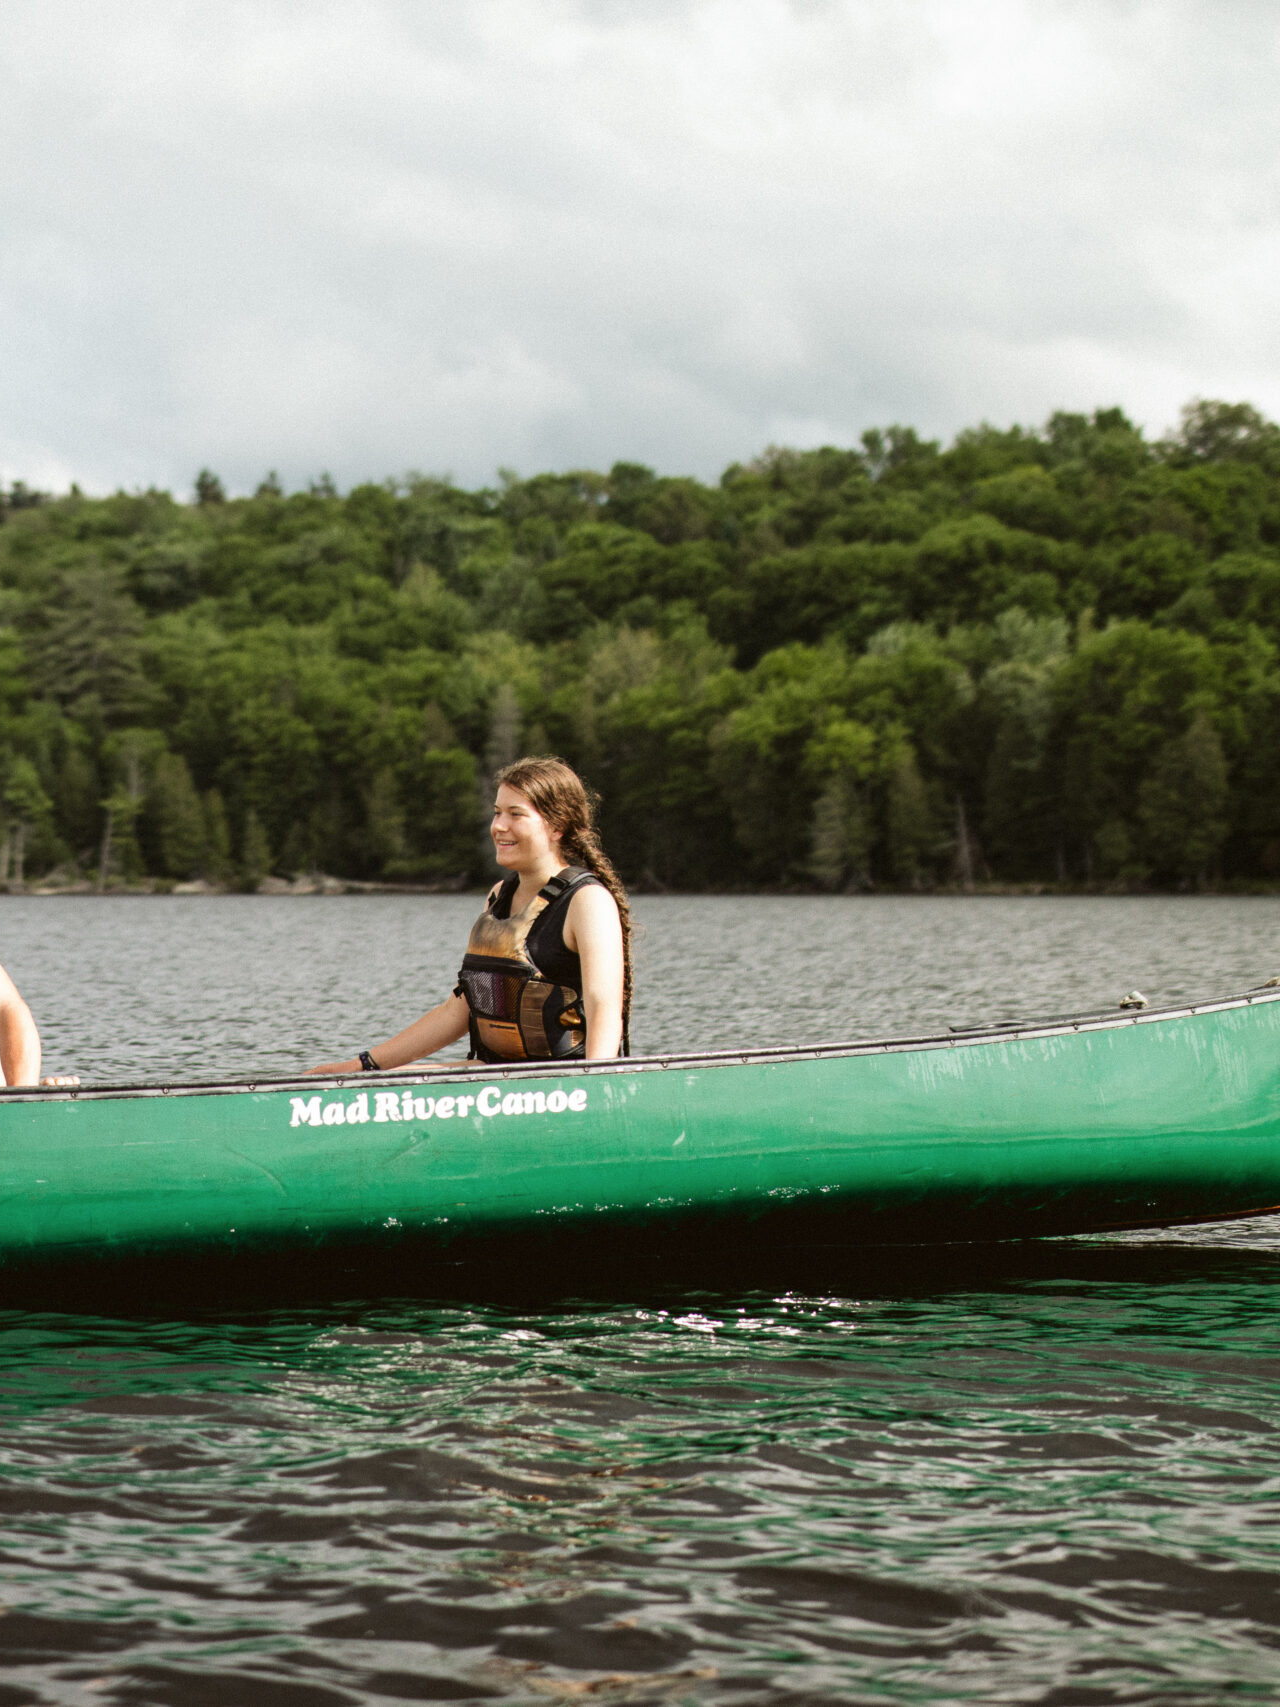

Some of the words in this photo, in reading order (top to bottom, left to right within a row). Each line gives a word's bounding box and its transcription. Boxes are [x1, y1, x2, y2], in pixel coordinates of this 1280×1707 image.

[289, 1092, 370, 1127] Mad
[372, 1090, 475, 1123] River
[476, 1086, 588, 1117] Canoe
